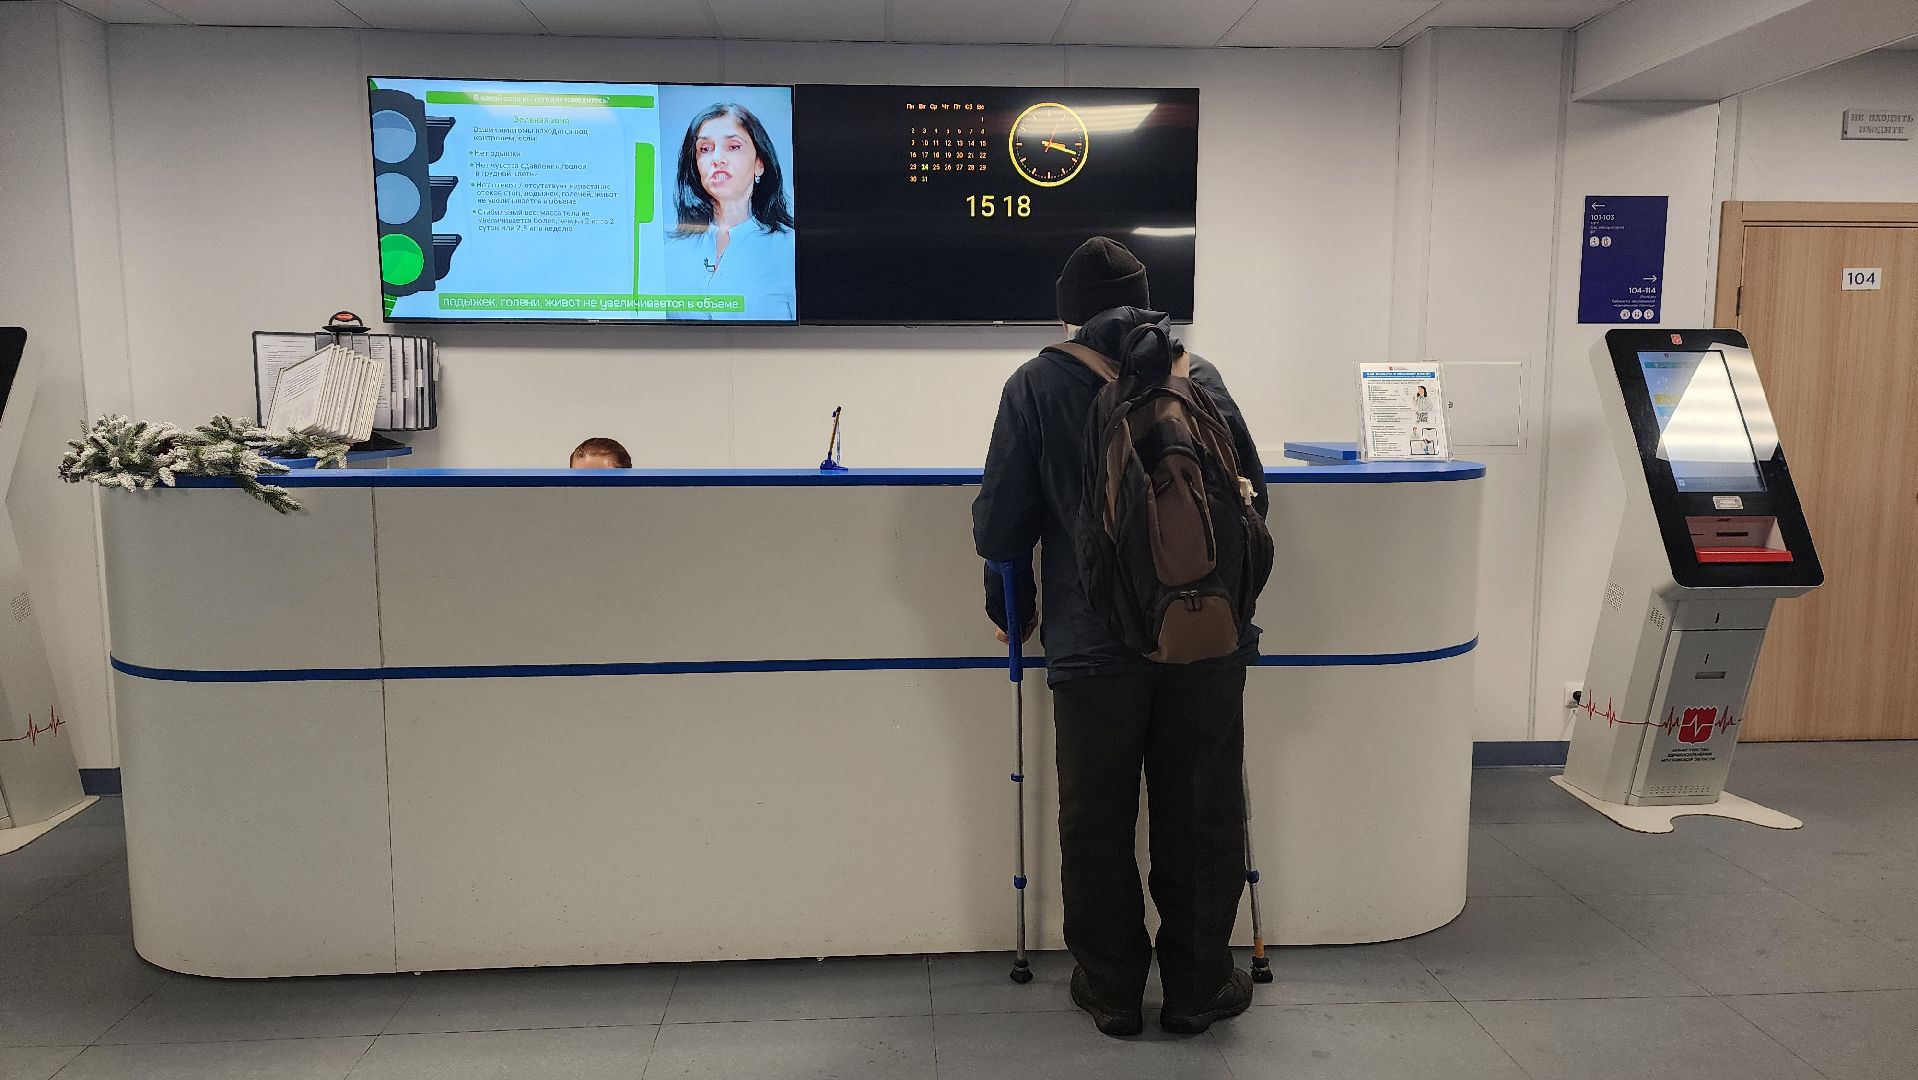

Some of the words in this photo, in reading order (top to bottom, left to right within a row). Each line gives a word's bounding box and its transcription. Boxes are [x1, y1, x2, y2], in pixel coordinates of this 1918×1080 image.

[944, 139, 952, 147] 12
[956, 139, 963, 147] 13
[944, 151, 952, 159] 19
[955, 151, 964, 159] 20
[967, 151, 974, 159] 21
[909, 163, 917, 171] 23
[921, 163, 929, 171] 24
[932, 163, 940, 171] 25
[944, 163, 952, 171] 26
[955, 163, 963, 171] 27
[1847, 271, 1876, 286] 104
[1628, 286, 1657, 294] 104-114
[442, 297, 498, 308] лодыжек,
[545, 298, 581, 308] живот
[582, 299, 598, 308] не
[599, 298, 685, 310] увеличивается
[687, 300, 694, 309] в
[696, 296, 739, 309] объеме
